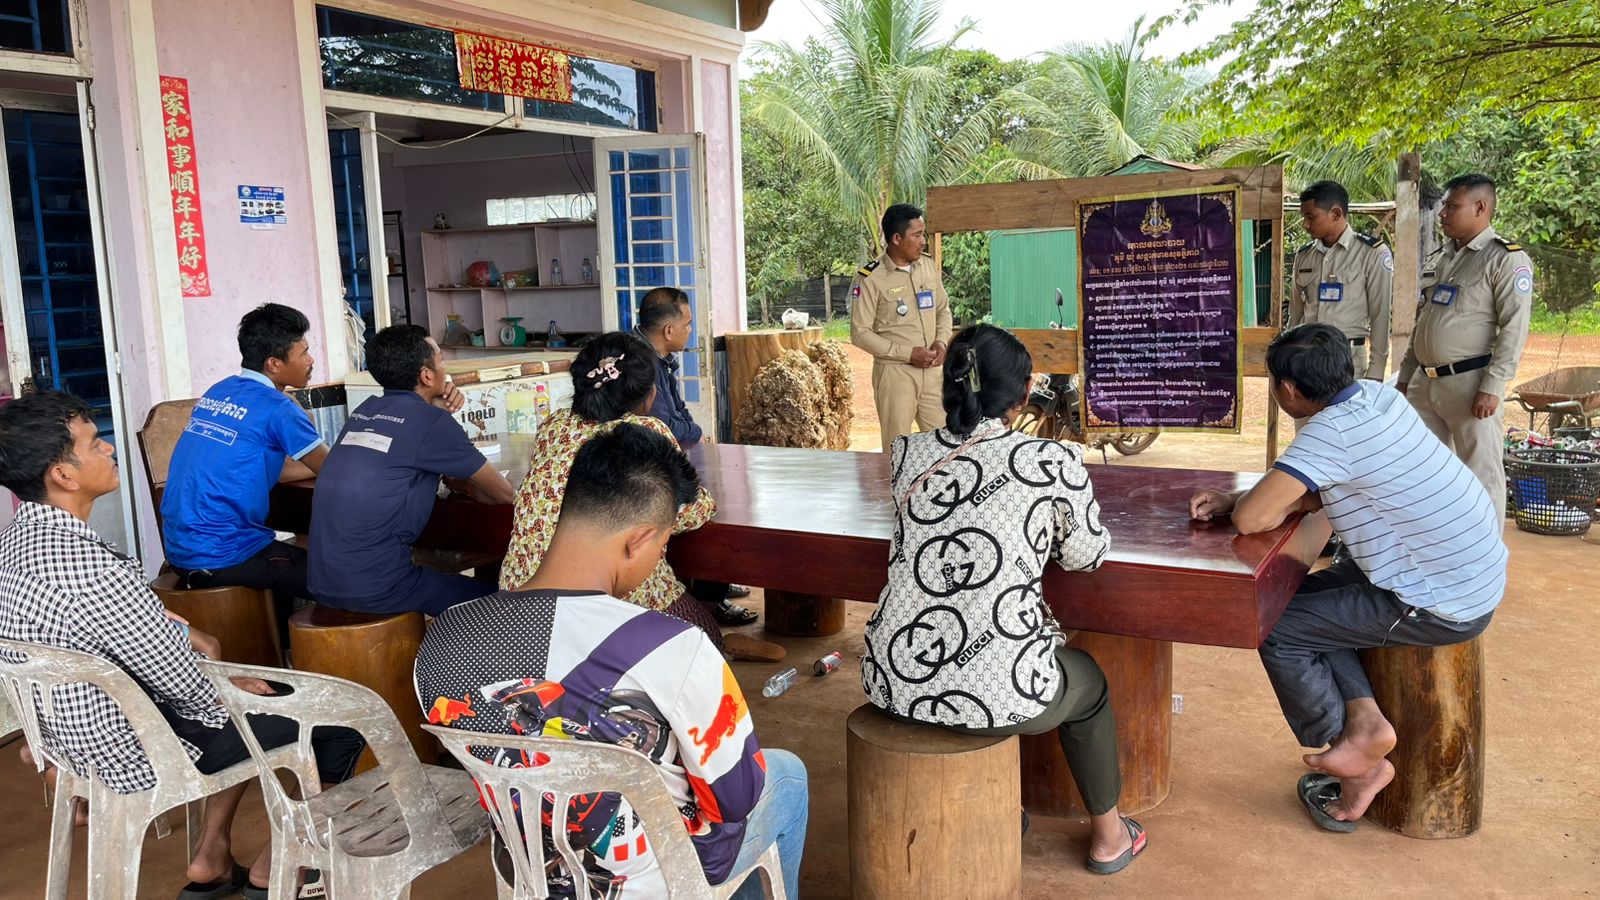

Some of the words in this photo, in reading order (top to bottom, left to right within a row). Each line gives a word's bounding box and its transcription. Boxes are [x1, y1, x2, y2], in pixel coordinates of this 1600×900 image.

[162, 90, 202, 270] 家和事順年年好
[973, 474, 1008, 504] GUCCI
[958, 632, 991, 665] GUCCI
